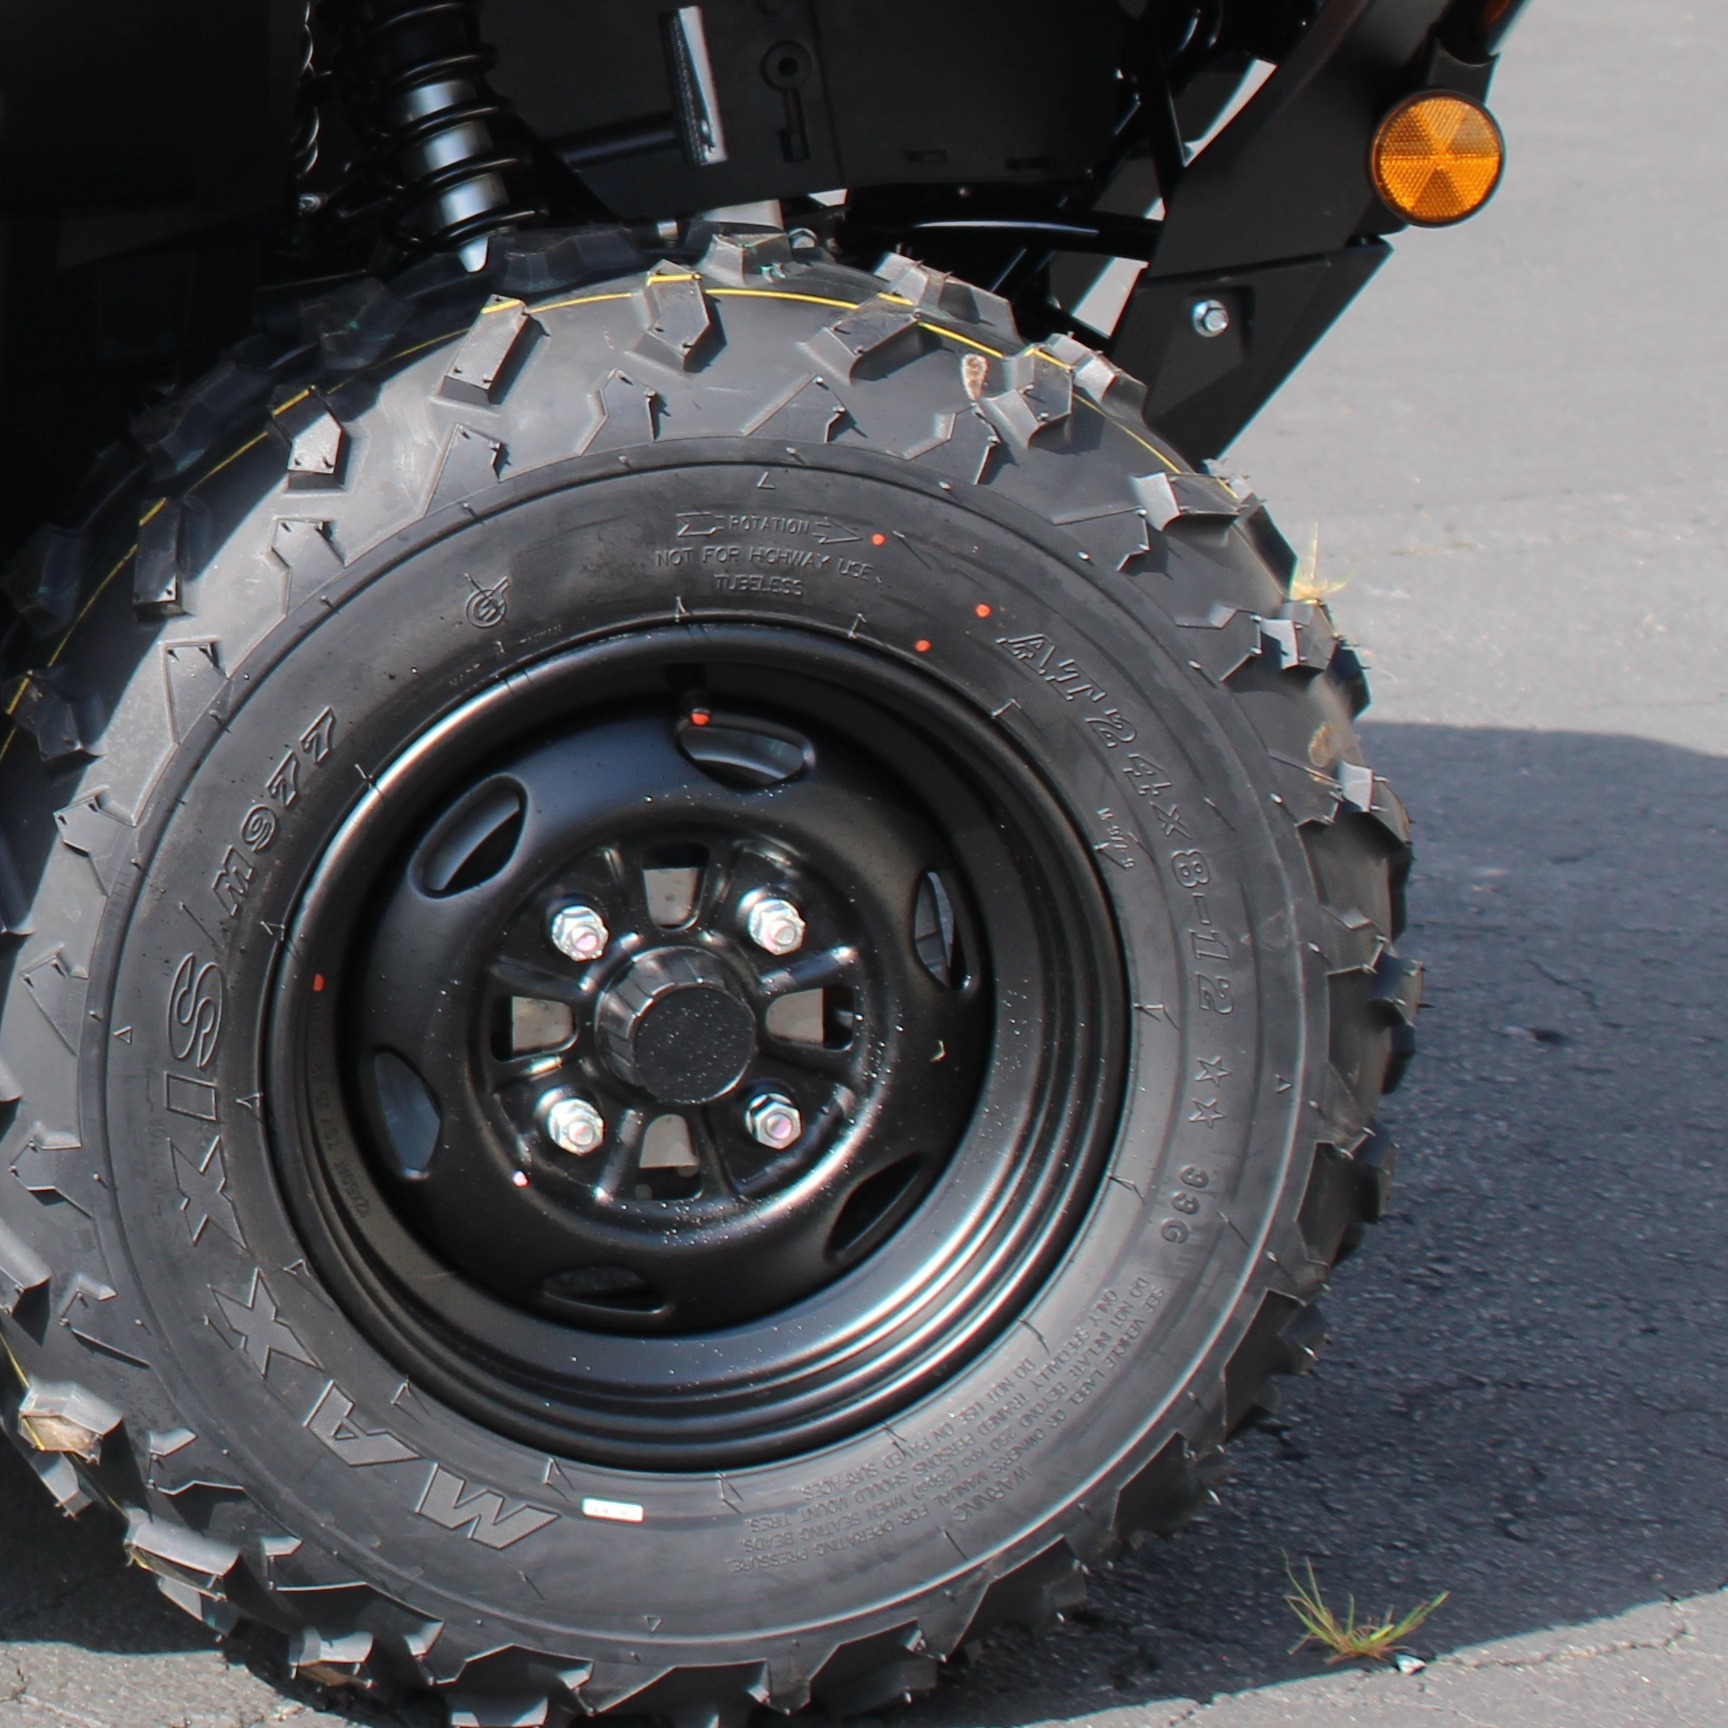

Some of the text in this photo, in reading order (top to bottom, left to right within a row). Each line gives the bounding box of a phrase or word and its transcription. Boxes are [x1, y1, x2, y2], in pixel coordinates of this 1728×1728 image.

[729, 515, 811, 536] ROTATION
[656, 546, 875, 581] NOT FOR HIGHWAY USE
[713, 573, 806, 596] TUBELESS
[164, 706, 560, 1549] MAXXIS M977
[950, 1463, 1031, 1524] WARNING
